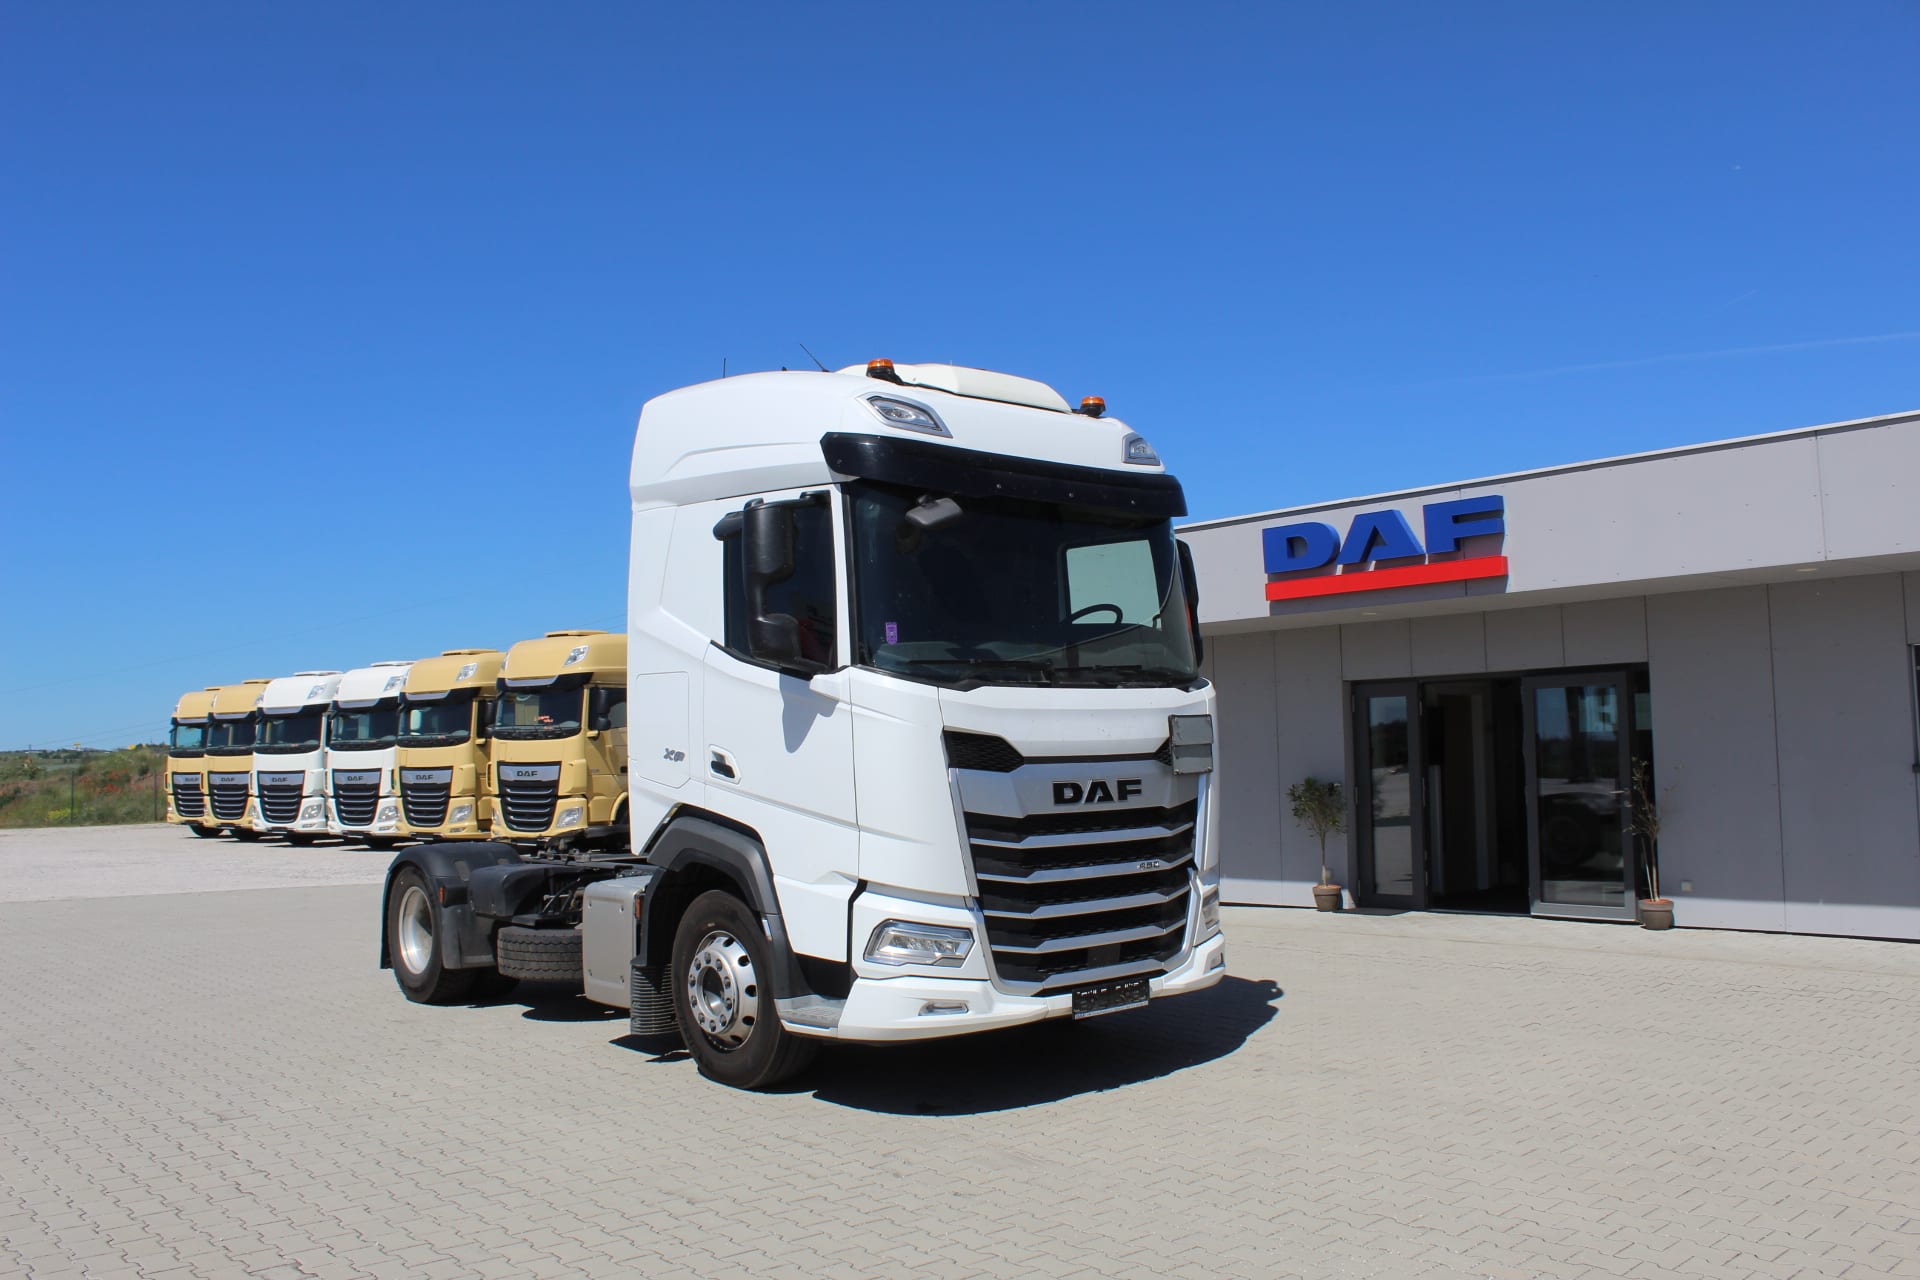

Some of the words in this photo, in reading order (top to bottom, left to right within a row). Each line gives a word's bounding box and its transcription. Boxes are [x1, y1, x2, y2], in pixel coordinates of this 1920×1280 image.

[1262, 495, 1505, 574] DAF
[516, 770, 539, 778] DAF
[1054, 779, 1142, 805] DAF
